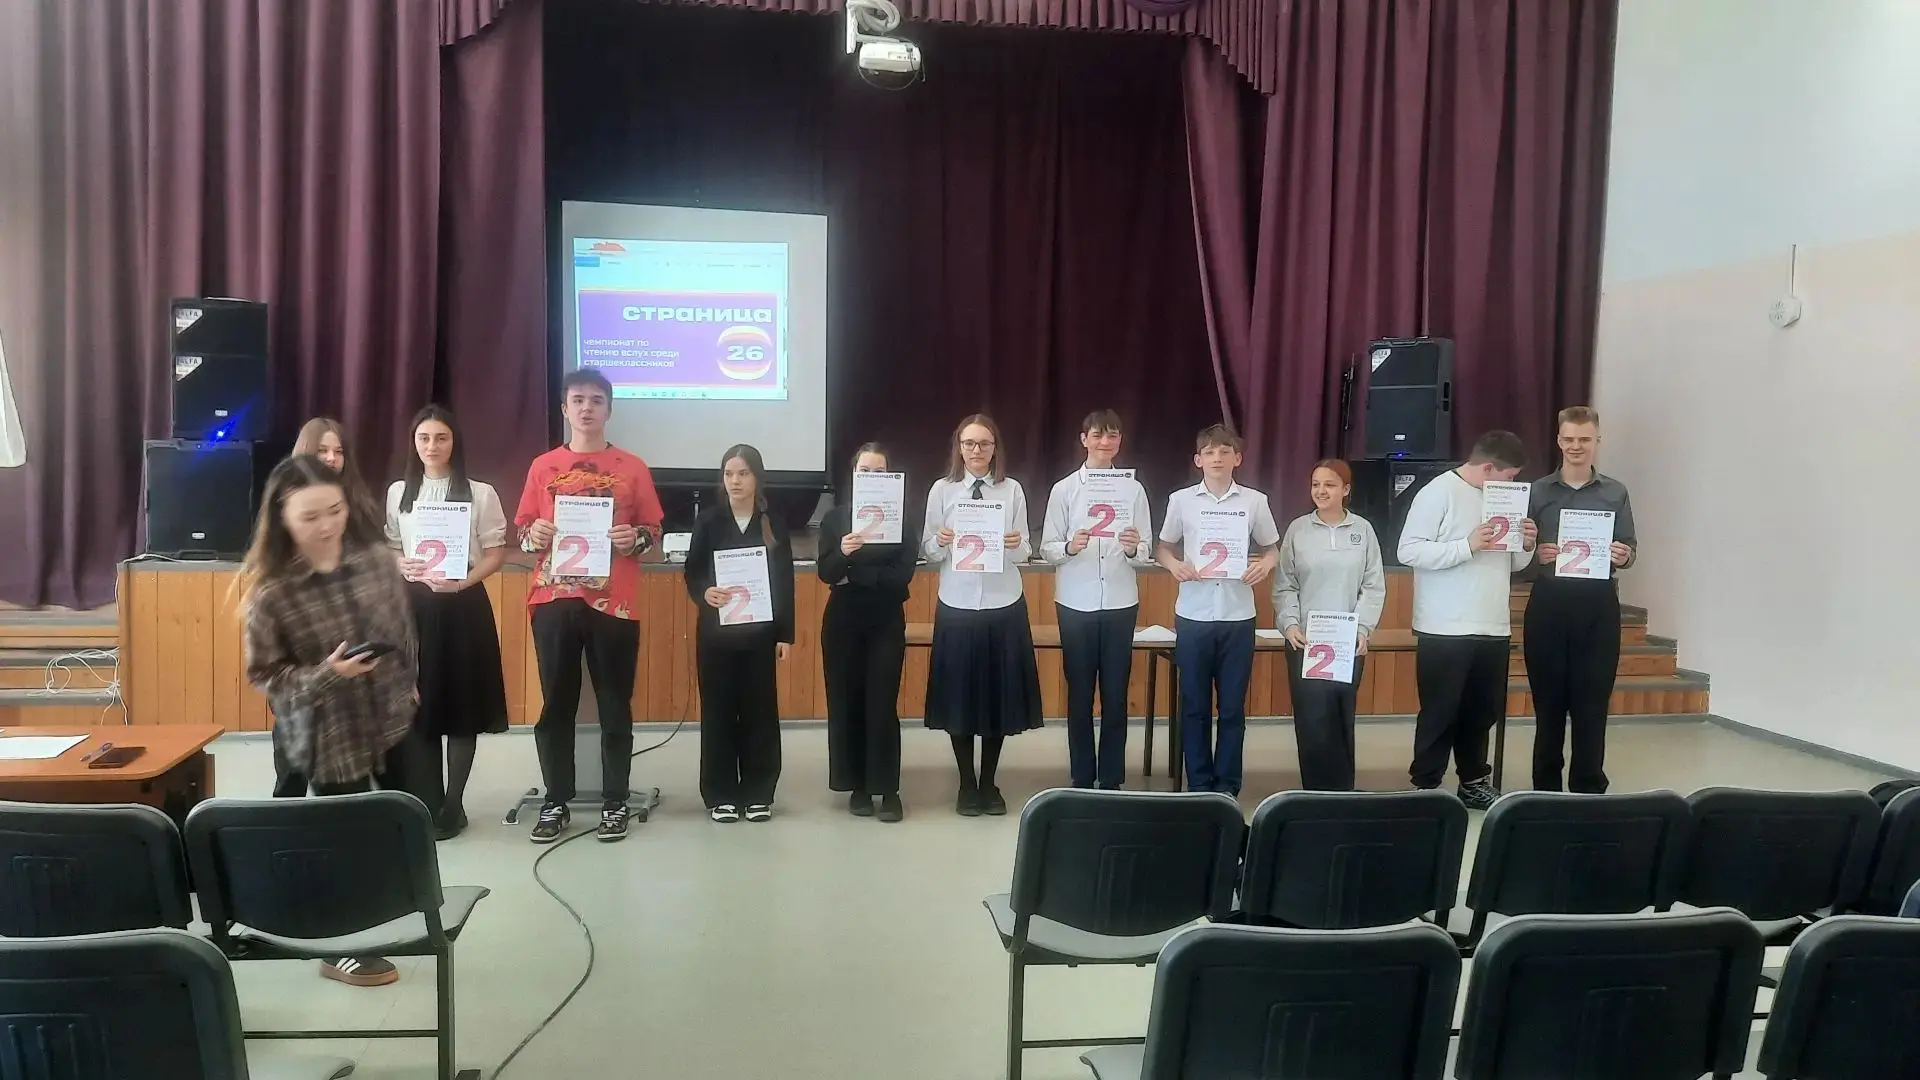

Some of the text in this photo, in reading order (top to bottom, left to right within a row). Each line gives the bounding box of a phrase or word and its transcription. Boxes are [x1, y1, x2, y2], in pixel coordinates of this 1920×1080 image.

[584, 339, 649, 347] чемпионат по
[621, 350, 649, 358] вслух
[650, 350, 680, 358] среди
[726, 345, 764, 361] 26
[584, 359, 675, 367] старшеклассников
[856, 505, 885, 540] 2
[1087, 503, 1116, 538] 2
[1487, 516, 1510, 551] 2
[415, 539, 447, 577] 2
[556, 535, 590, 575] 2
[955, 534, 985, 571] 2
[1198, 541, 1228, 578] 2
[1560, 540, 1590, 575] 2
[723, 585, 754, 624] 2
[1305, 644, 1336, 679] 2
